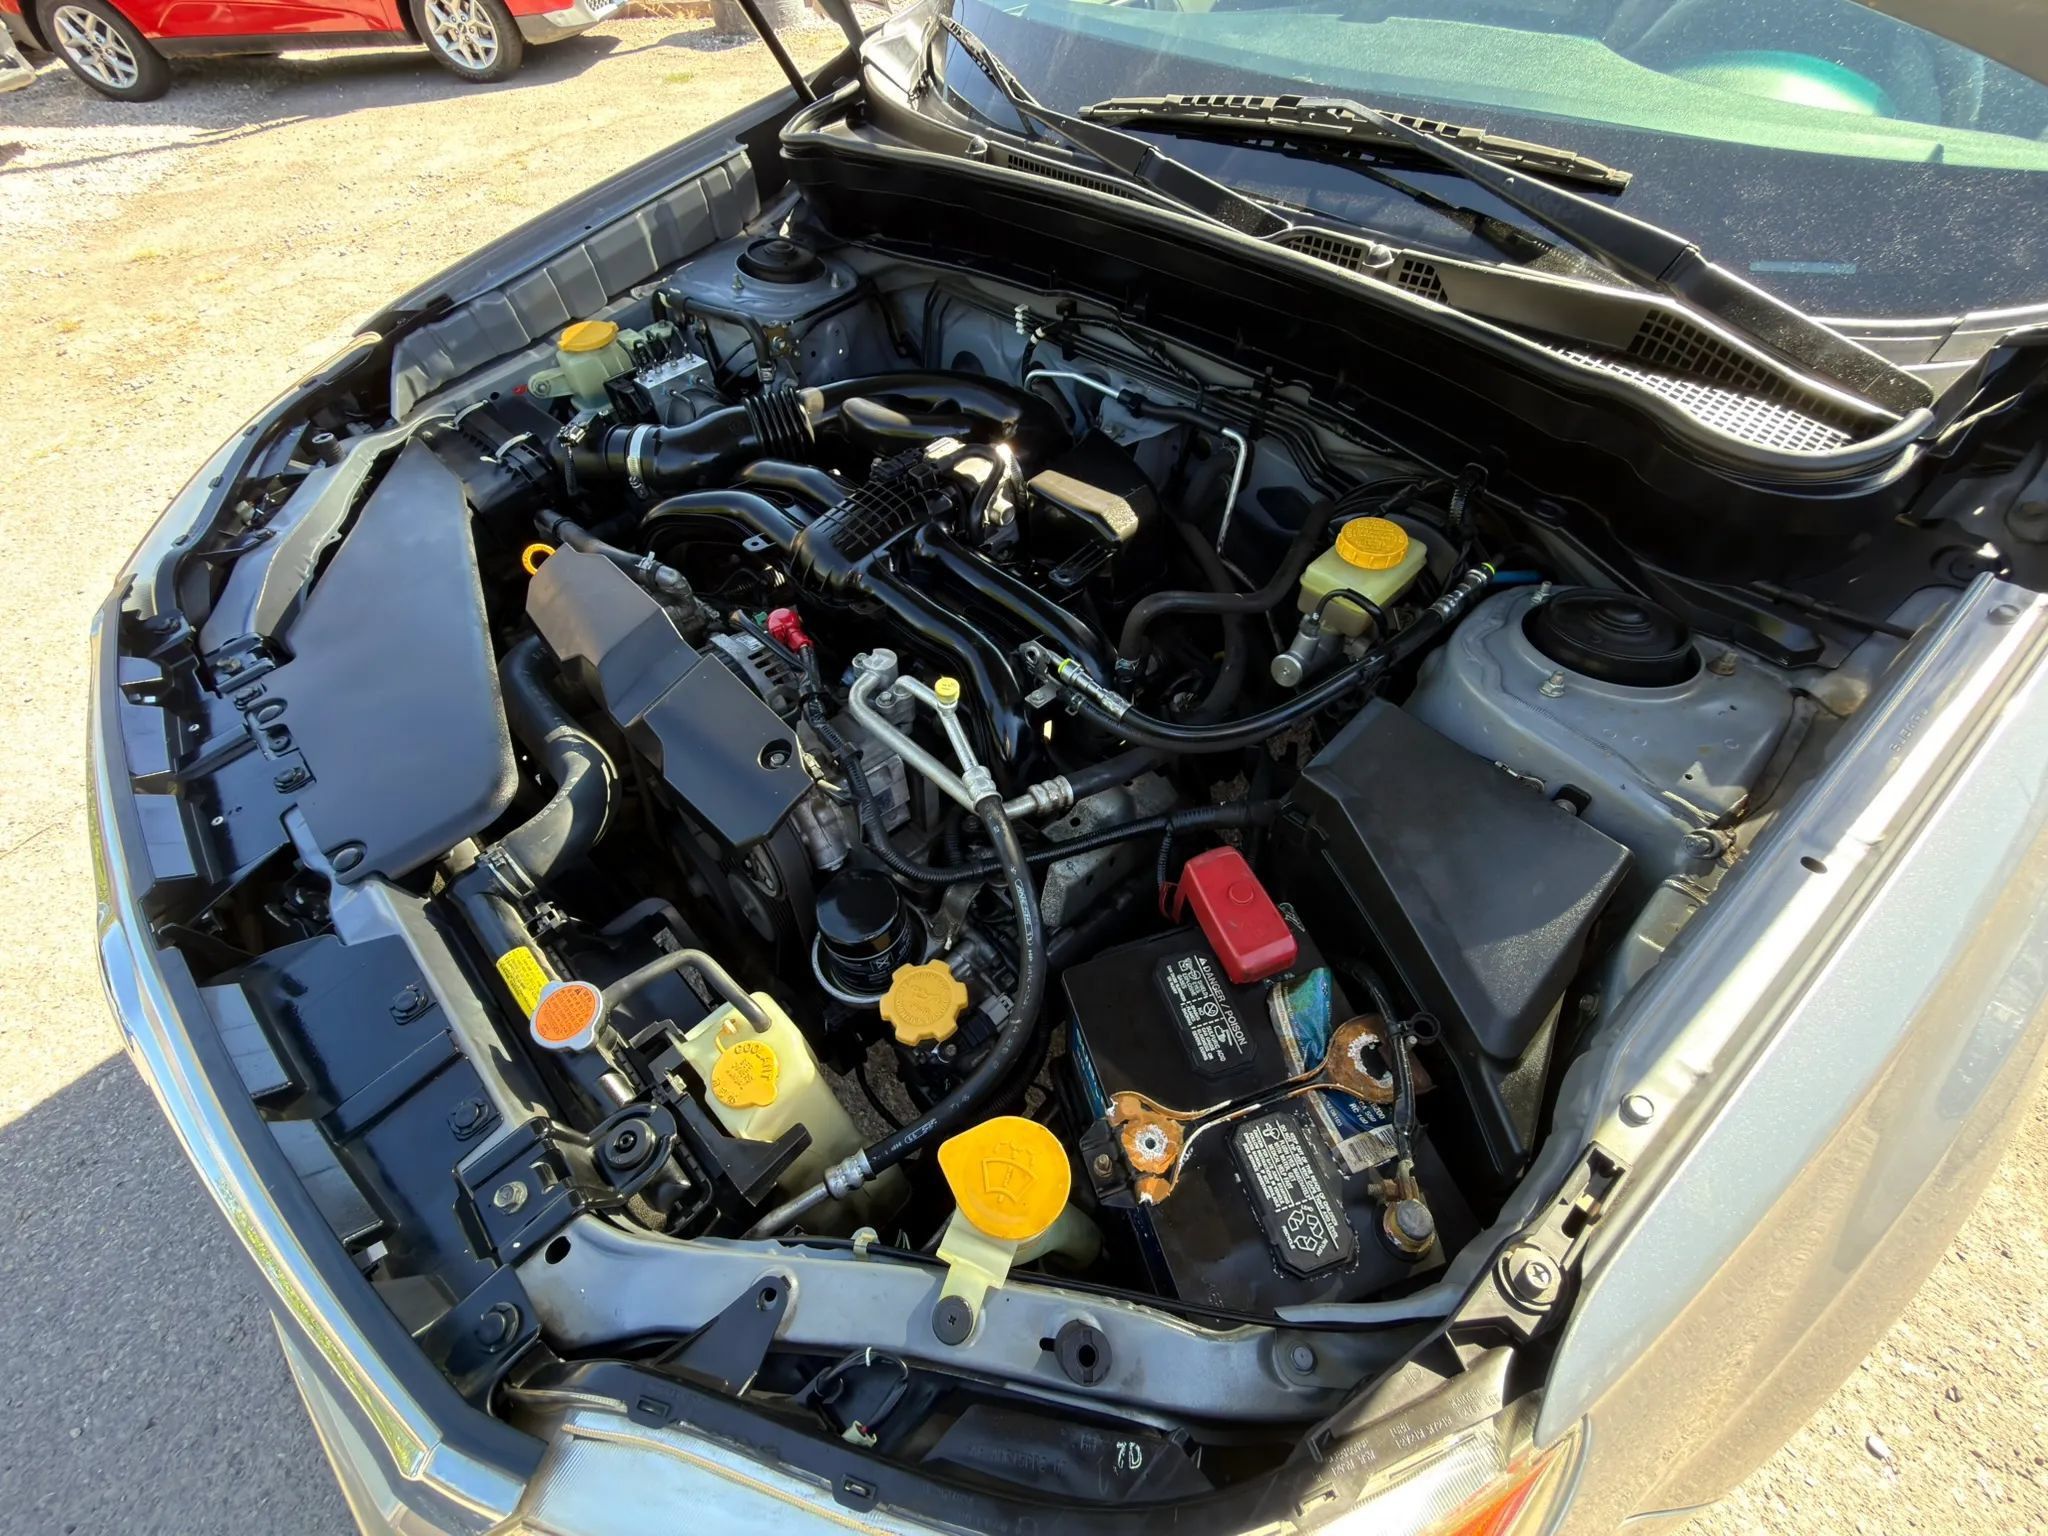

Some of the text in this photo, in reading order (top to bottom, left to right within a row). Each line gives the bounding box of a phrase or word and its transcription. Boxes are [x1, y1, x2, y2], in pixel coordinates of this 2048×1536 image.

[1197, 1006, 1204, 1016] NO
[1202, 964, 1225, 1002] DANGER
[1224, 1009, 1247, 1045] POISON
[734, 1043, 772, 1080] COOLANT
[1205, 1025, 1226, 1062] SULFURIC ACID
[1348, 1102, 1360, 1114] RC
[1283, 1132, 1292, 1144] NOT
[1293, 1152, 1303, 1166] KEEP
[1300, 1166, 1310, 1179] VENT
[1289, 1131, 1298, 1145] KEEP
[1295, 1145, 1304, 1156] OUT
[1304, 1164, 1313, 1175] THE
[1309, 1174, 1321, 1192] REACH
[1286, 1171, 1296, 1182] GET
